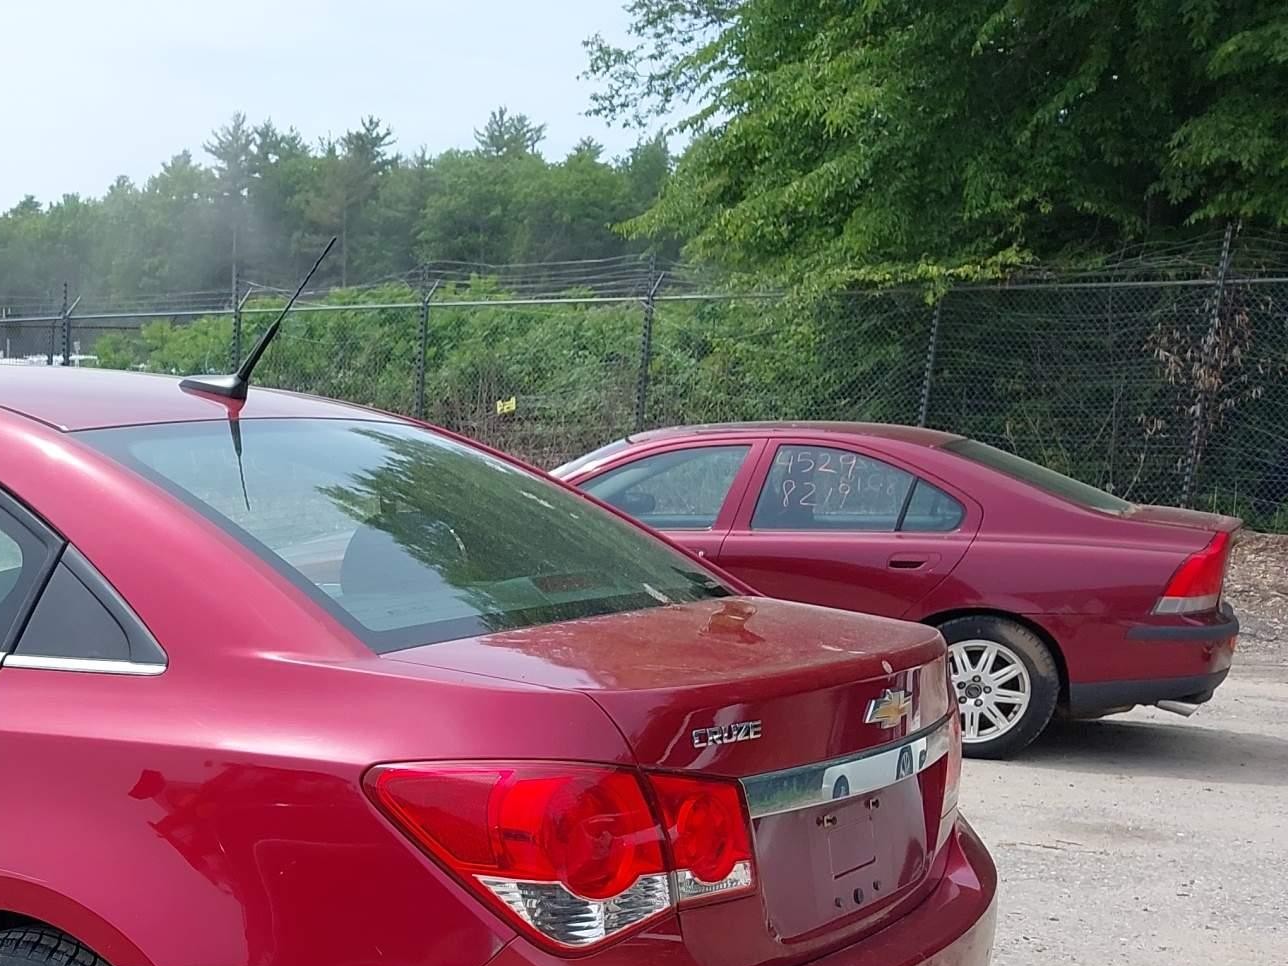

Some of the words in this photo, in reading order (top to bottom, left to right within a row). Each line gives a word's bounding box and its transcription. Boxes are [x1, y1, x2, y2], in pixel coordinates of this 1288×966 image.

[776, 451, 856, 479] 4529
[782, 479, 851, 508] 8219
[692, 720, 762, 749] CRUZE
